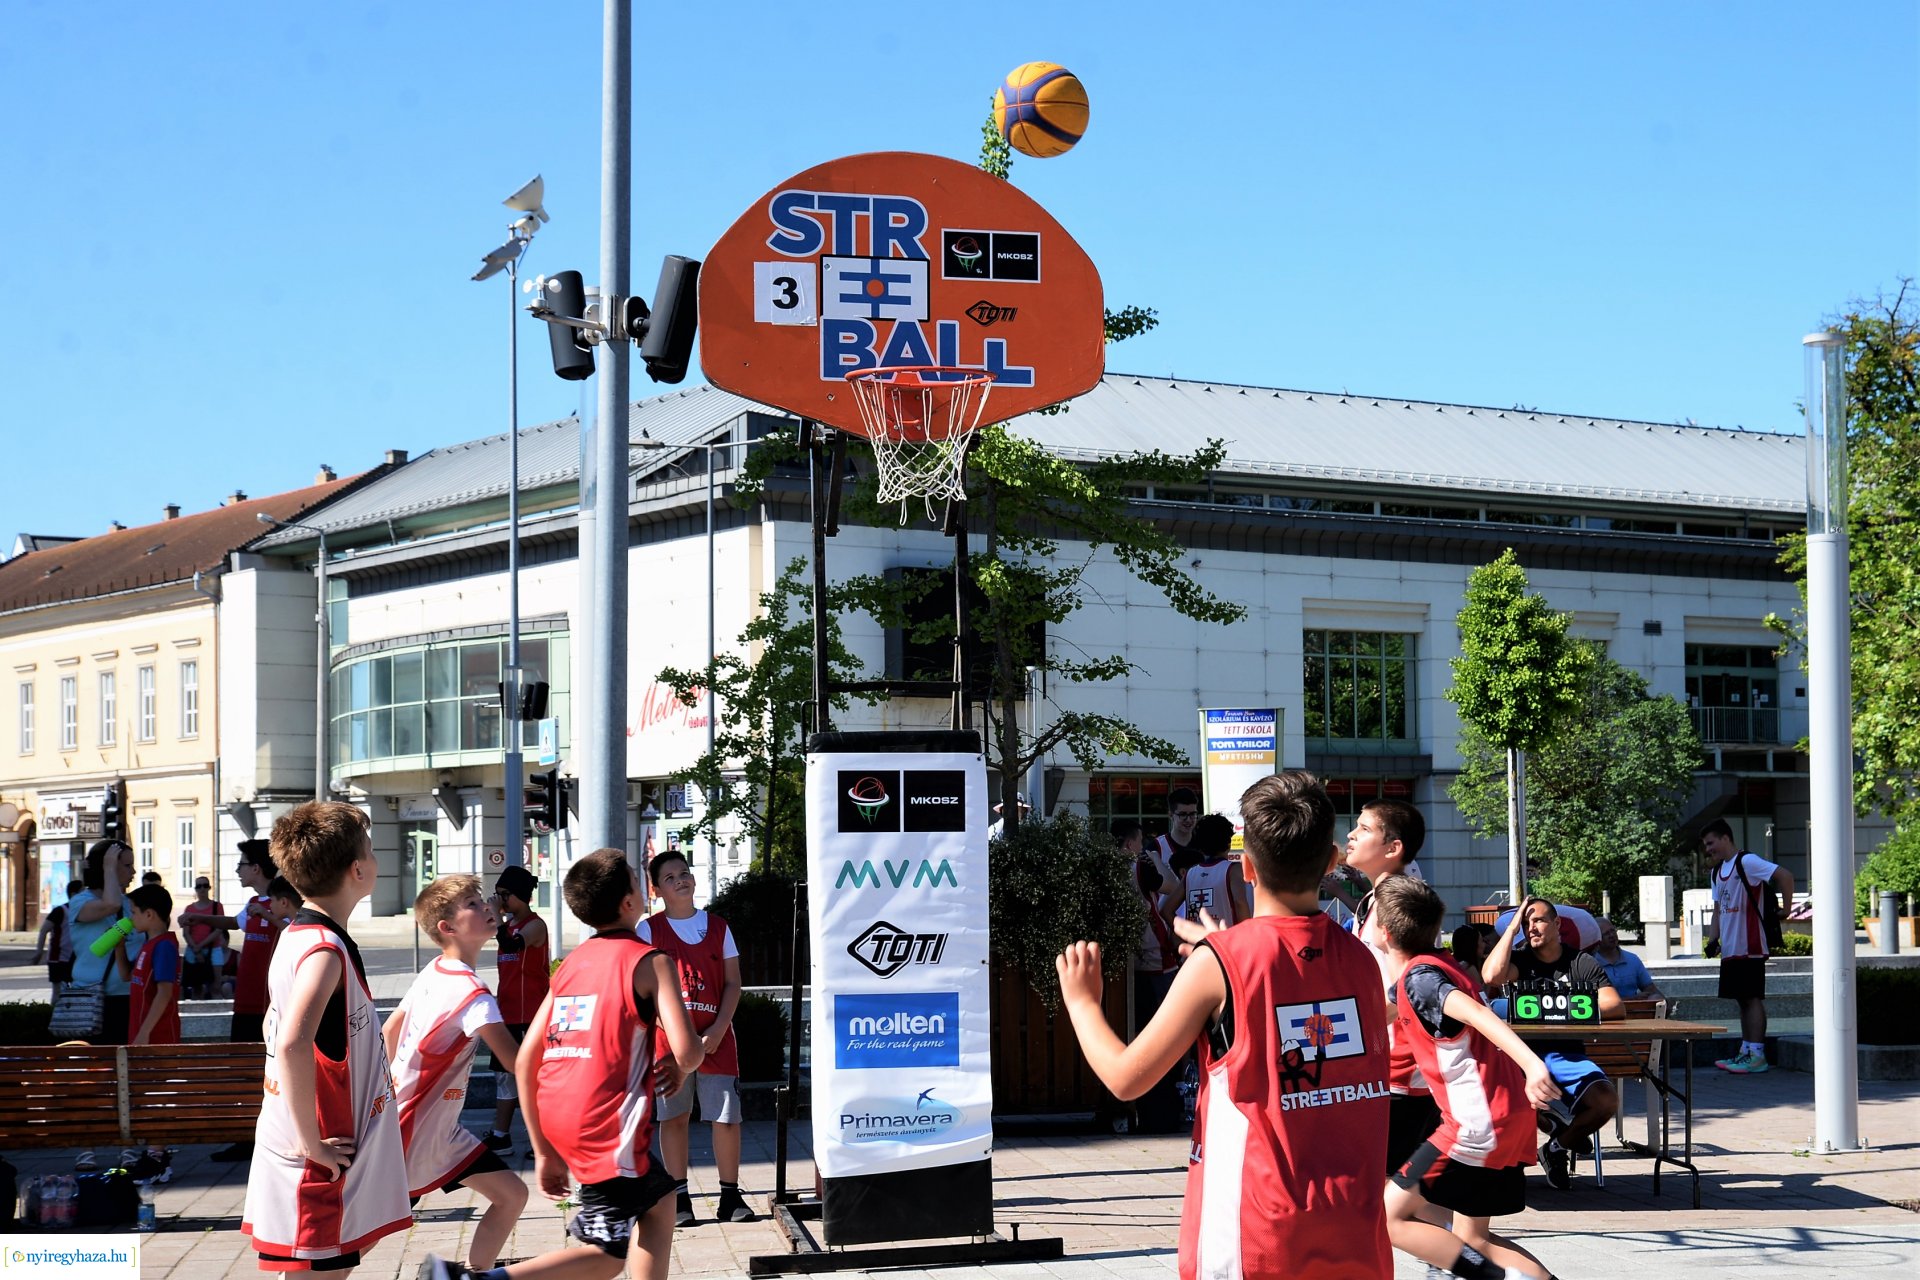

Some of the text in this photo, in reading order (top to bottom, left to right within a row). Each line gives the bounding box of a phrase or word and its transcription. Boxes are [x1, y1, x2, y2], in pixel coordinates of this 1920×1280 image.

[766, 190, 929, 260] STR
[997, 252, 1034, 261] MKOSZ
[772, 277, 800, 310] 3
[977, 306, 1018, 322] TOTI
[819, 316, 1035, 387] BALL
[1223, 725, 1272, 735] TETT ISKOLA
[1210, 740, 1270, 749] TOM TAILOR
[910, 796, 959, 805] MKOSZ
[835, 859, 958, 889] MVM
[870, 933, 949, 966] TOTI
[1516, 995, 1540, 1019] 6
[1570, 995, 1593, 1020] 3
[849, 1012, 946, 1036] molten
[847, 1037, 945, 1052] For the real game
[840, 1113, 953, 1130] Primavera
[856, 1127, 937, 1139] természetes ásványvíz
